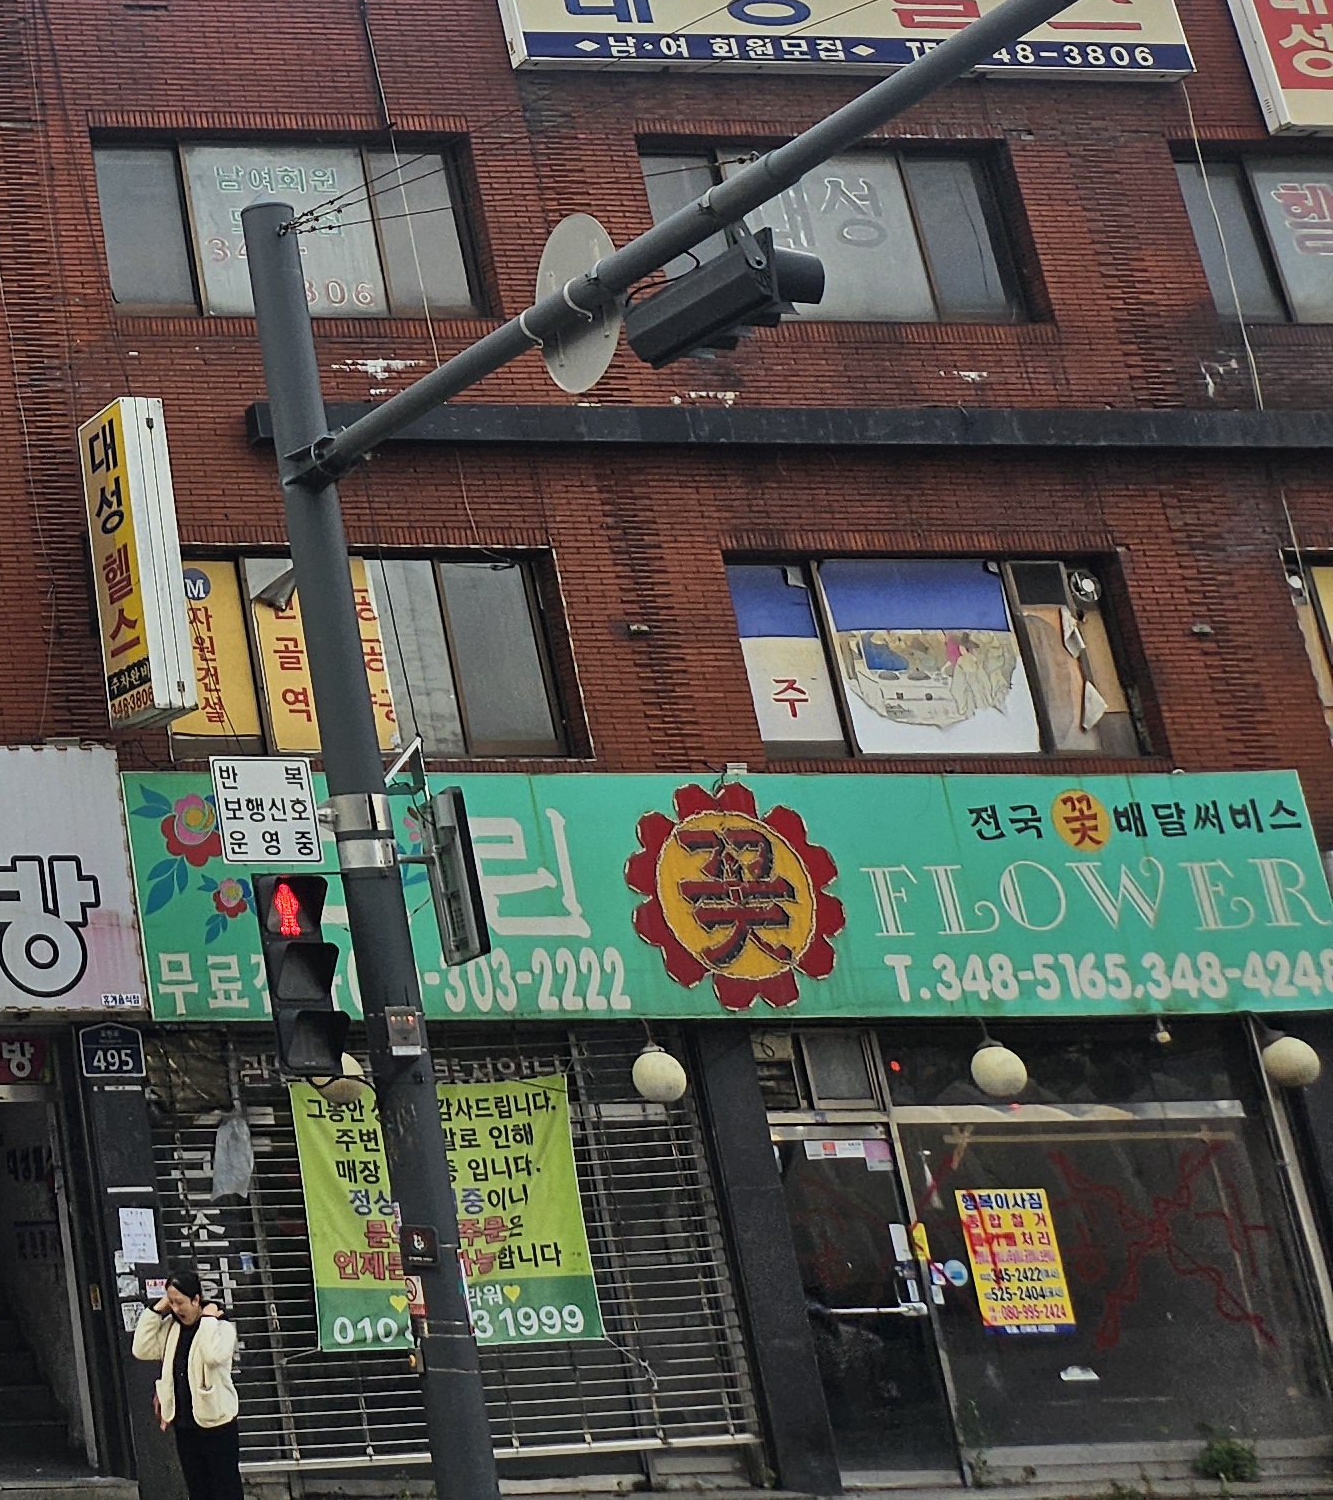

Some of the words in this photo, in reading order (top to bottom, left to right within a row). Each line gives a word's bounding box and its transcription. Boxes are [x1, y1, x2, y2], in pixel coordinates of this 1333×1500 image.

[709, 37, 845, 61] 회원모집
[992, 44, 1155, 67] 48-3806
[187, 605, 225, 723] 자원건설
[223, 797, 310, 824] 보행신호
[967, 804, 1043, 841] 전국
[1060, 790, 1102, 850] 꽃
[227, 829, 315, 857] 운영중
[676, 827, 798, 969] 꽃
[859, 855, 1332, 937] FLOWER
[93, 1049, 134, 1071] 495
[335, 1127, 381, 1153] 주변
[489, 1123, 534, 1149] 인해
[335, 1158, 381, 1184] 매장
[467, 1153, 541, 1181] 입니다.
